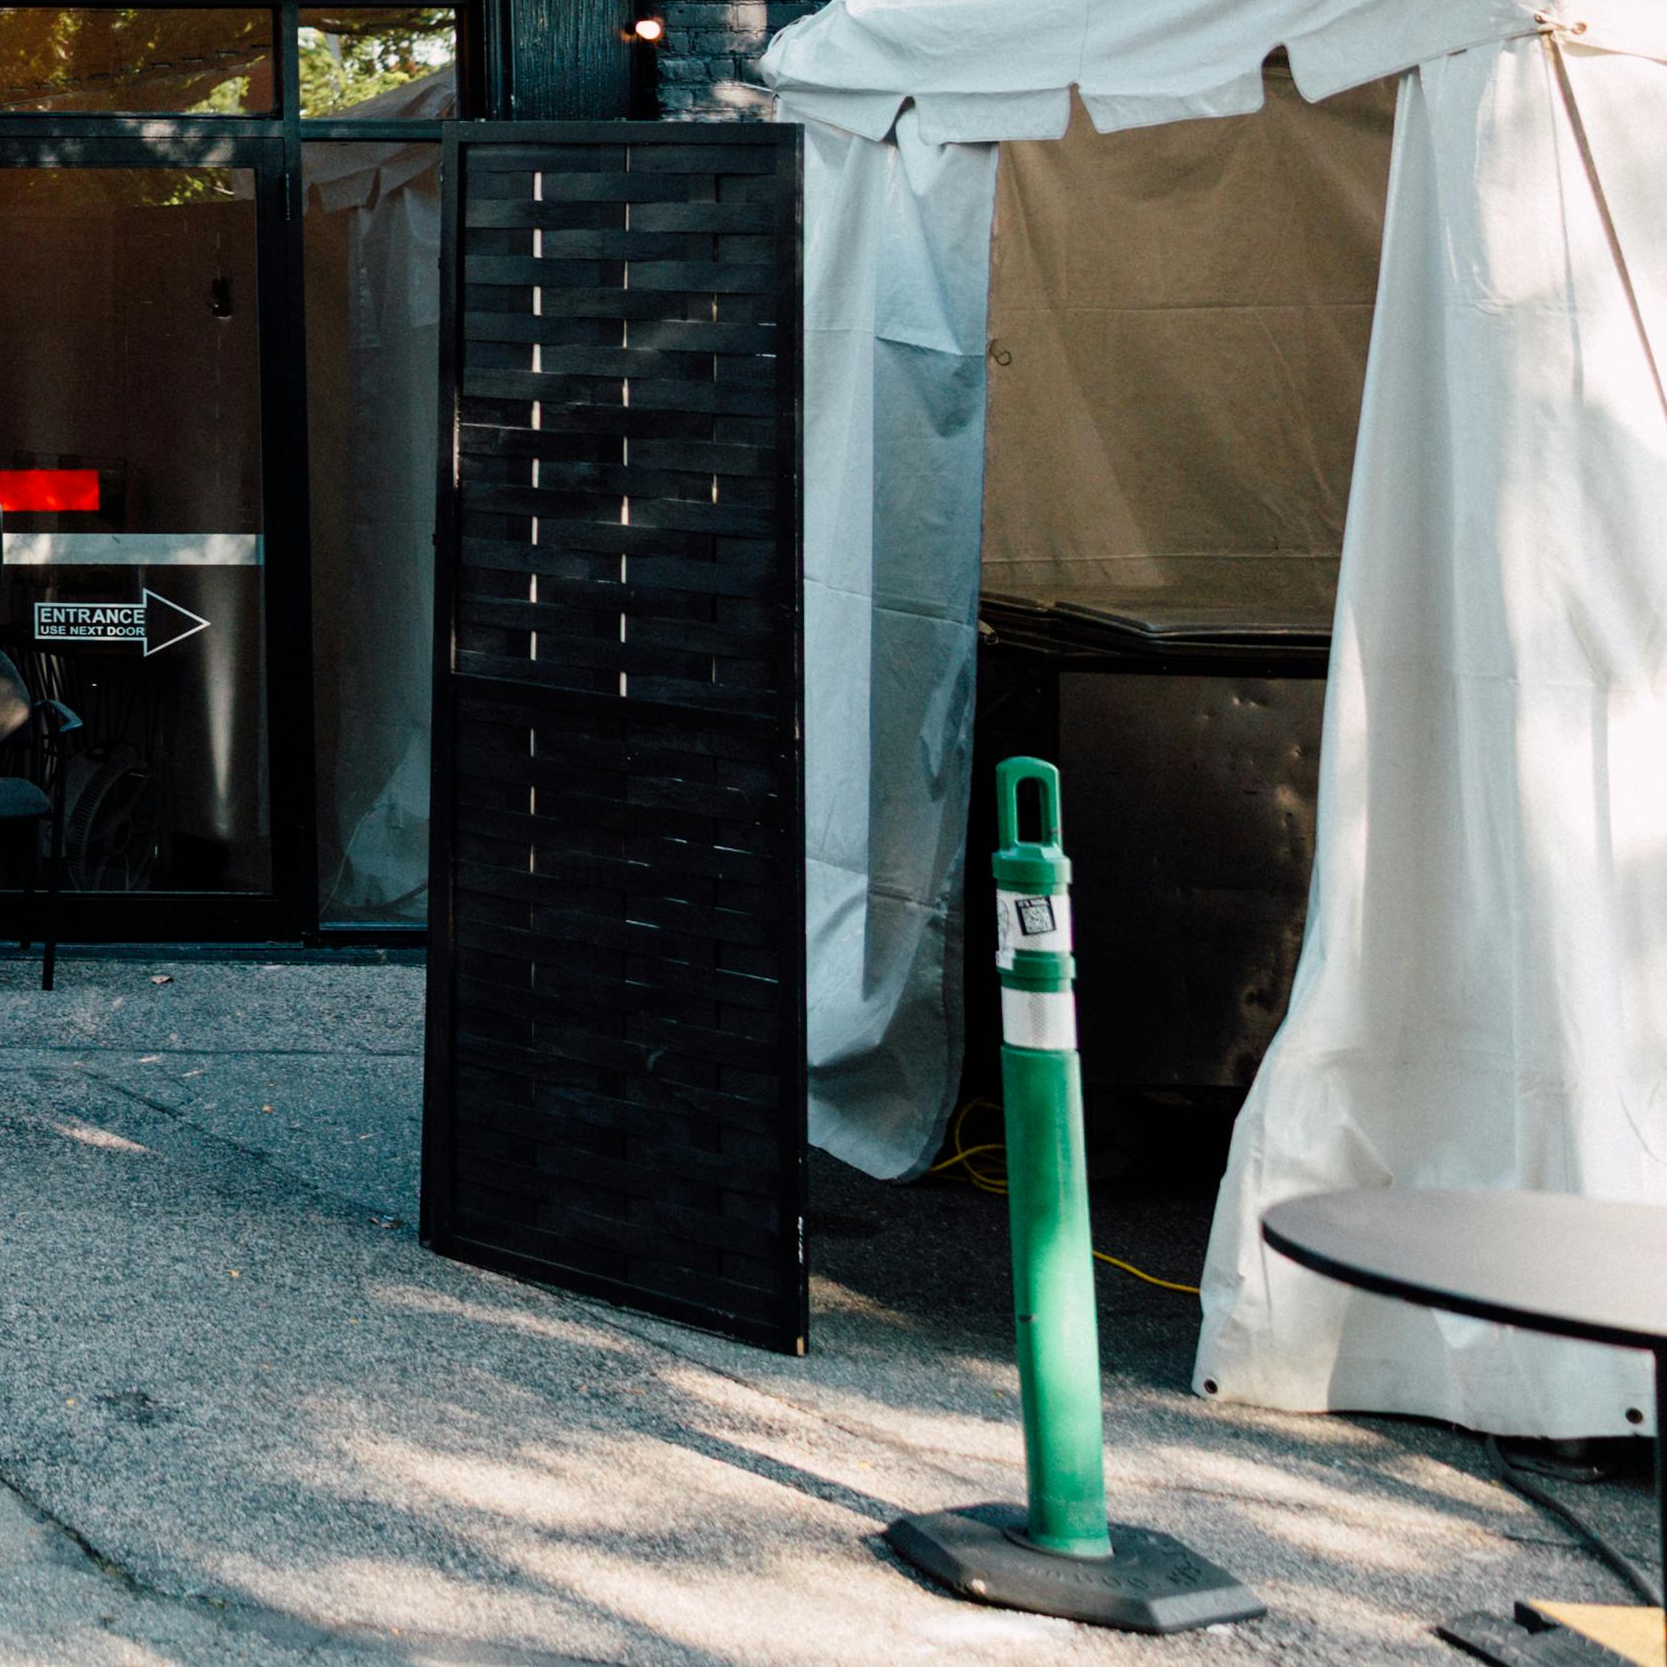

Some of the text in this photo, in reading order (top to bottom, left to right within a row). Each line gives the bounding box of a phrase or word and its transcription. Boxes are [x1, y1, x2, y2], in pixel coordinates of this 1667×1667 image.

[40, 608, 145, 624] ENTRANCE
[40, 625, 145, 636] USE NEXT DOOR
